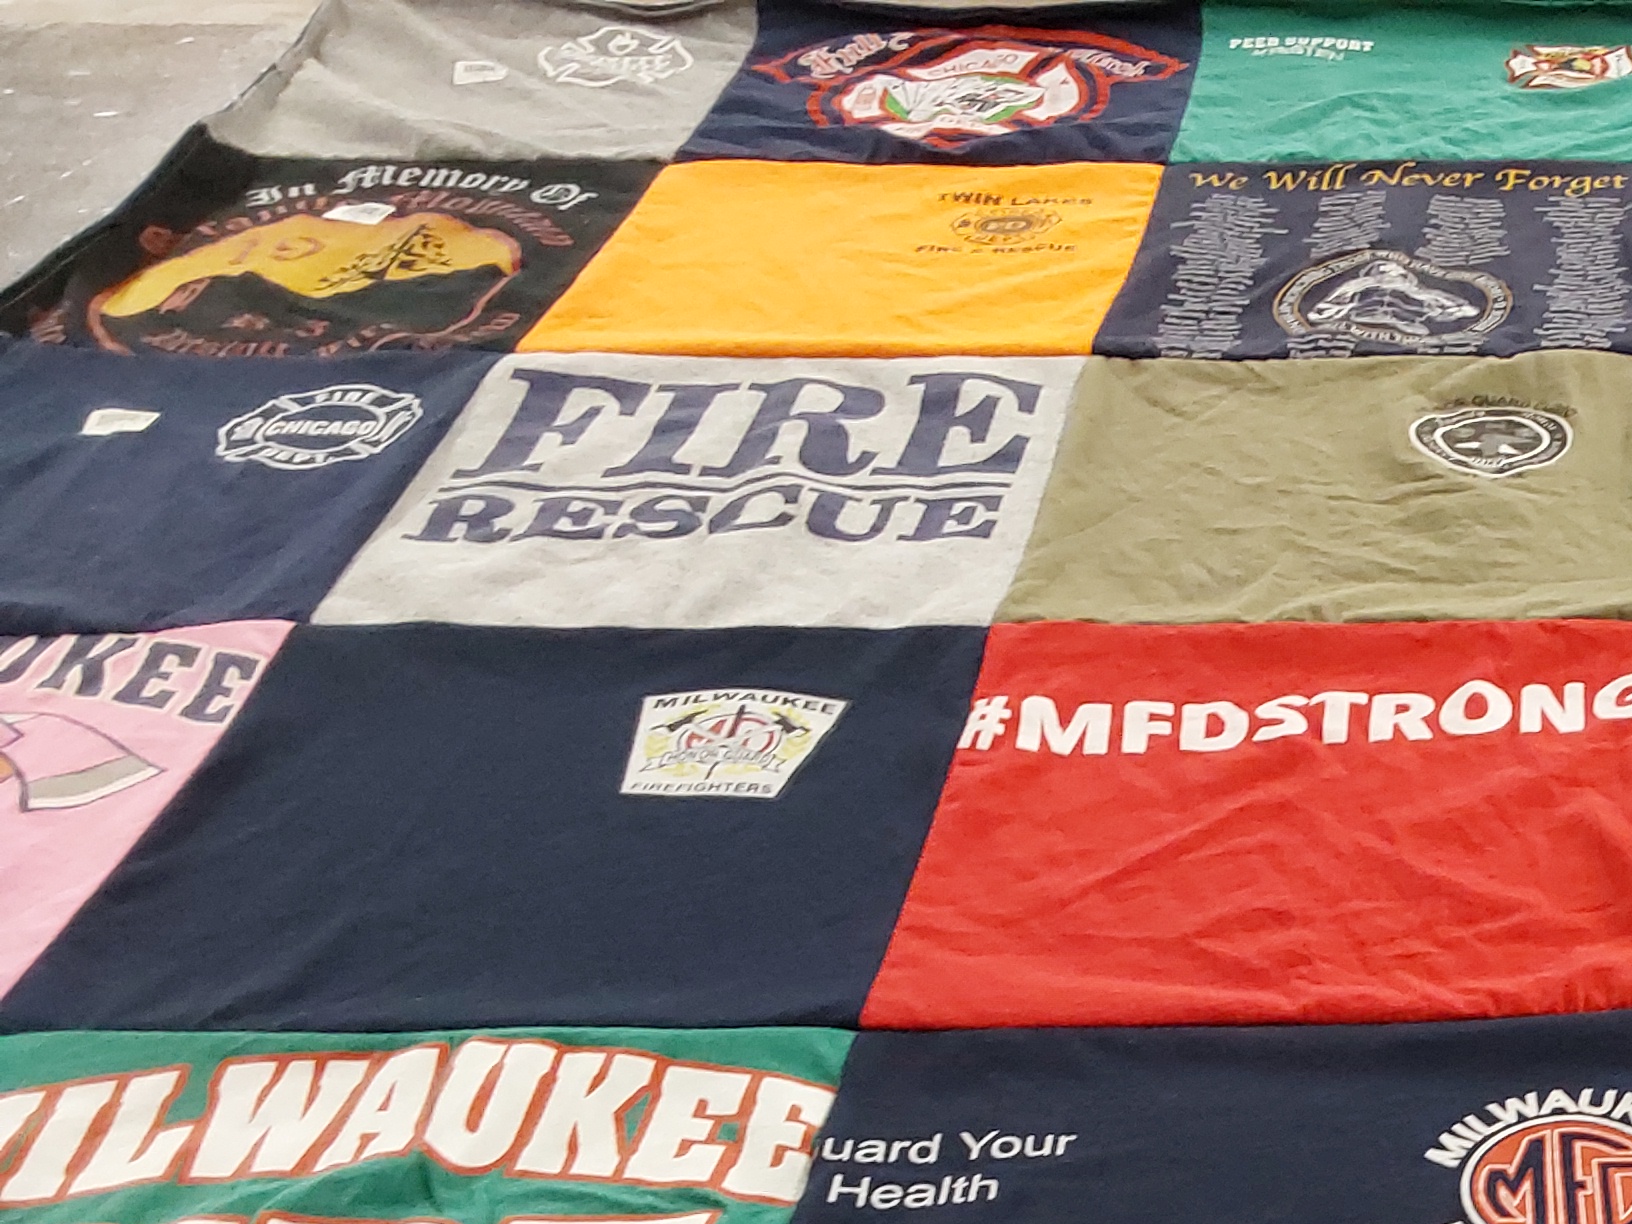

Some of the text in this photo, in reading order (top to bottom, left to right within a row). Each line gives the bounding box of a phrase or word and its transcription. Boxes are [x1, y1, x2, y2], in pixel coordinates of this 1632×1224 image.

[331, 165, 532, 196] Memory
[1189, 161, 1629, 197] We Will Never Forget
[938, 191, 1002, 206] TWIN
[265, 419, 375, 437] CHICAGO
[452, 367, 1043, 479] FIRE
[401, 485, 1007, 543] RESCUE
[653, 691, 840, 716] MILWAUKEE
[630, 782, 775, 795] FIREFIGHTERS
[959, 1129, 1078, 1162] Your
[826, 1173, 999, 1211] Health
